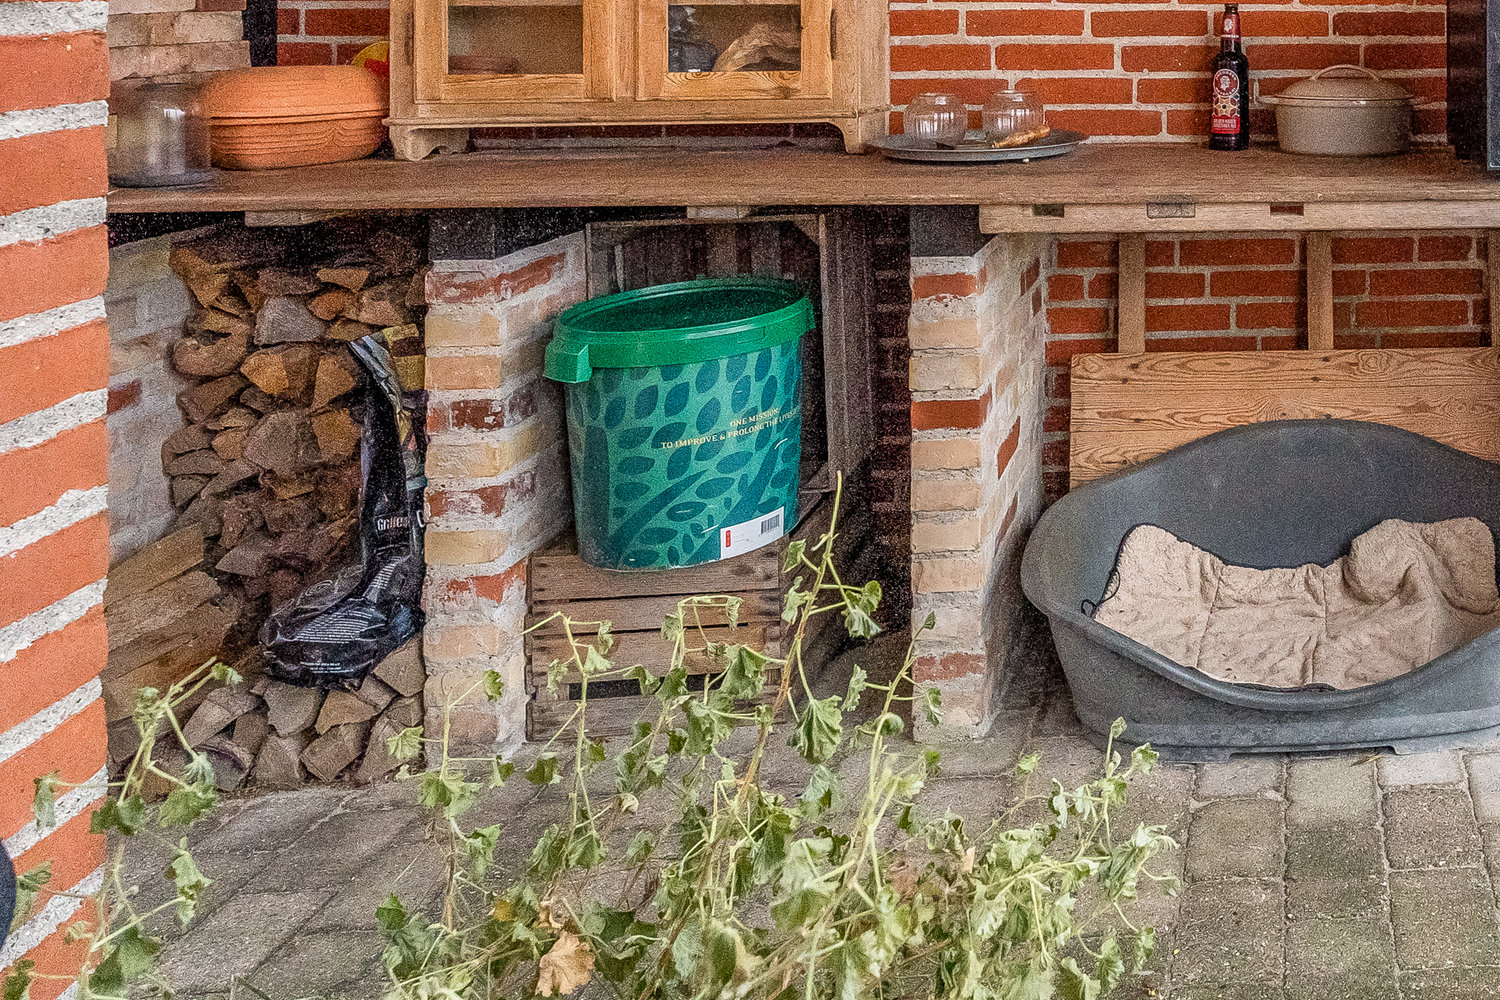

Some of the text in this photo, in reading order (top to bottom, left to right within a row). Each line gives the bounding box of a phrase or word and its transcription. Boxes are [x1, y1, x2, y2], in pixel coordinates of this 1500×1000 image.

[661, 441, 673, 449] TO
[674, 434, 717, 448] IMPROVE
[727, 422, 765, 438] PROLONG
[765, 417, 779, 428] THE
[729, 418, 747, 428] ONE
